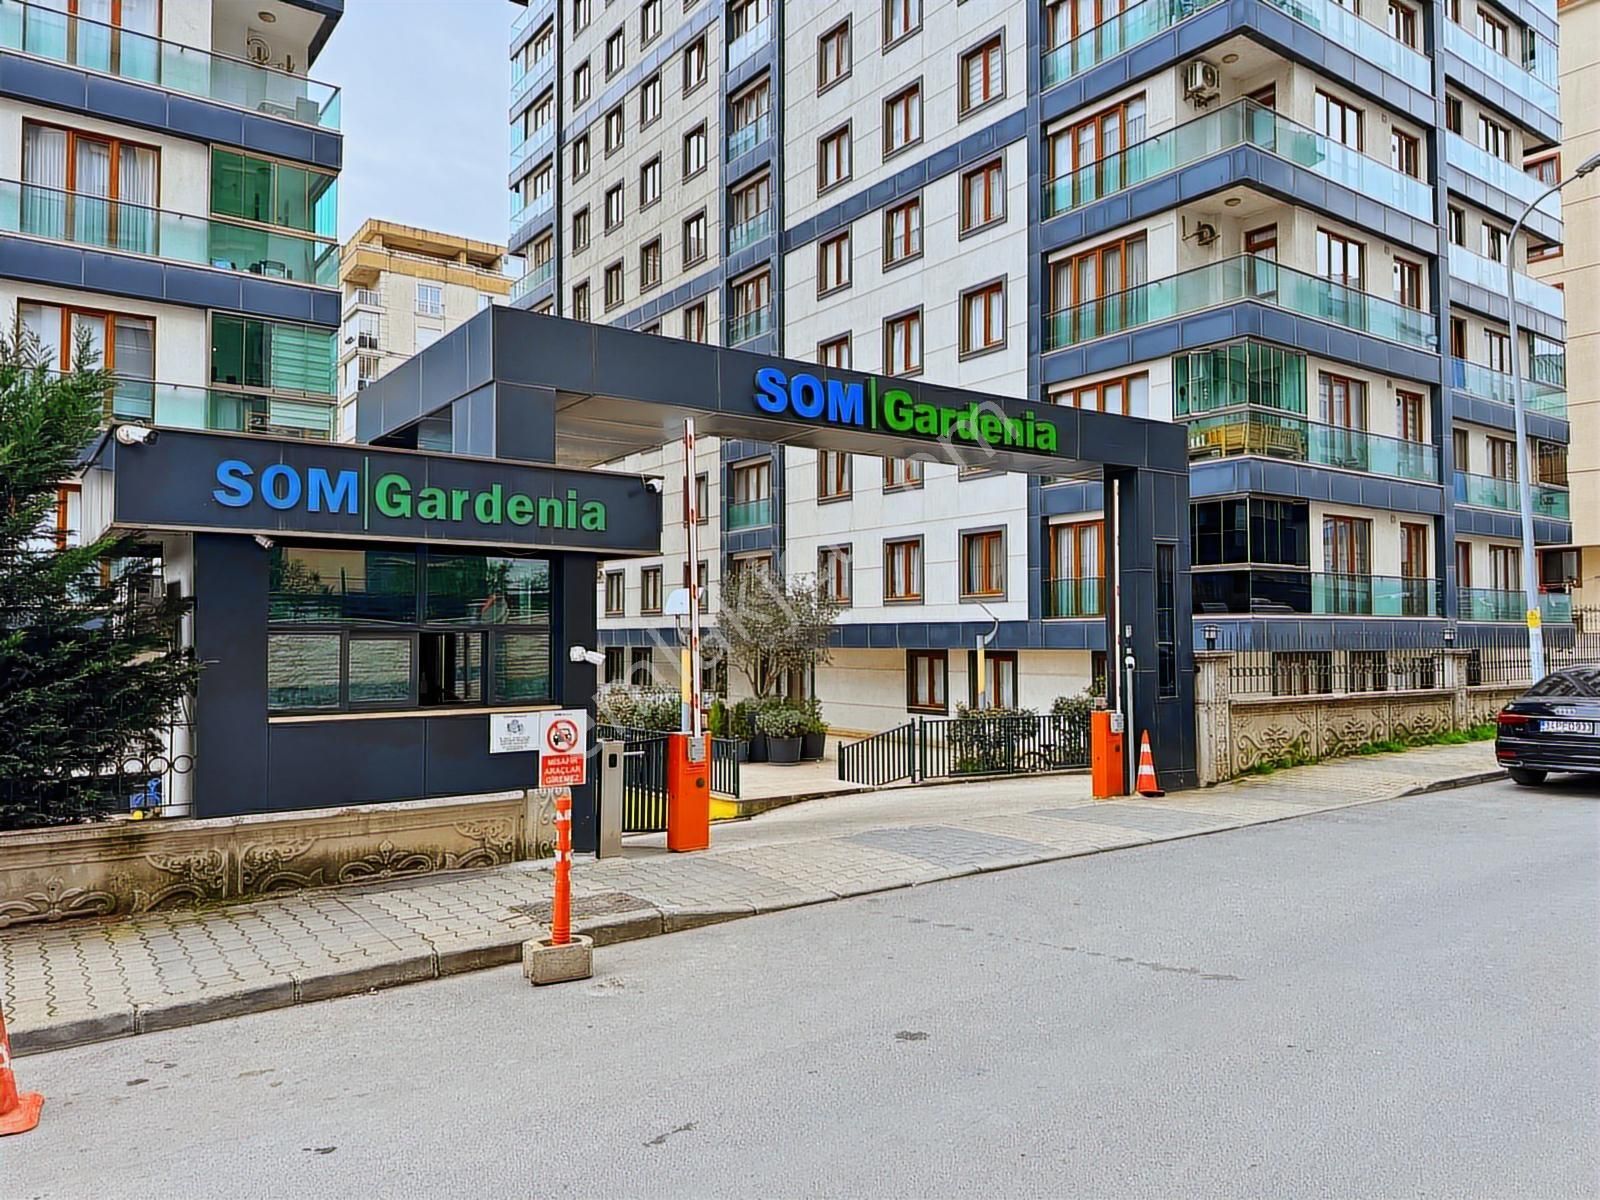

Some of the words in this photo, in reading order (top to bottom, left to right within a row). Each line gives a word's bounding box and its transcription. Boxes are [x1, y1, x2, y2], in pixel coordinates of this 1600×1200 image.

[755, 367, 864, 425] SOM
[883, 389, 1057, 452] Gardenia
[213, 459, 358, 514] SOM
[374, 473, 607, 531] Gardenia
